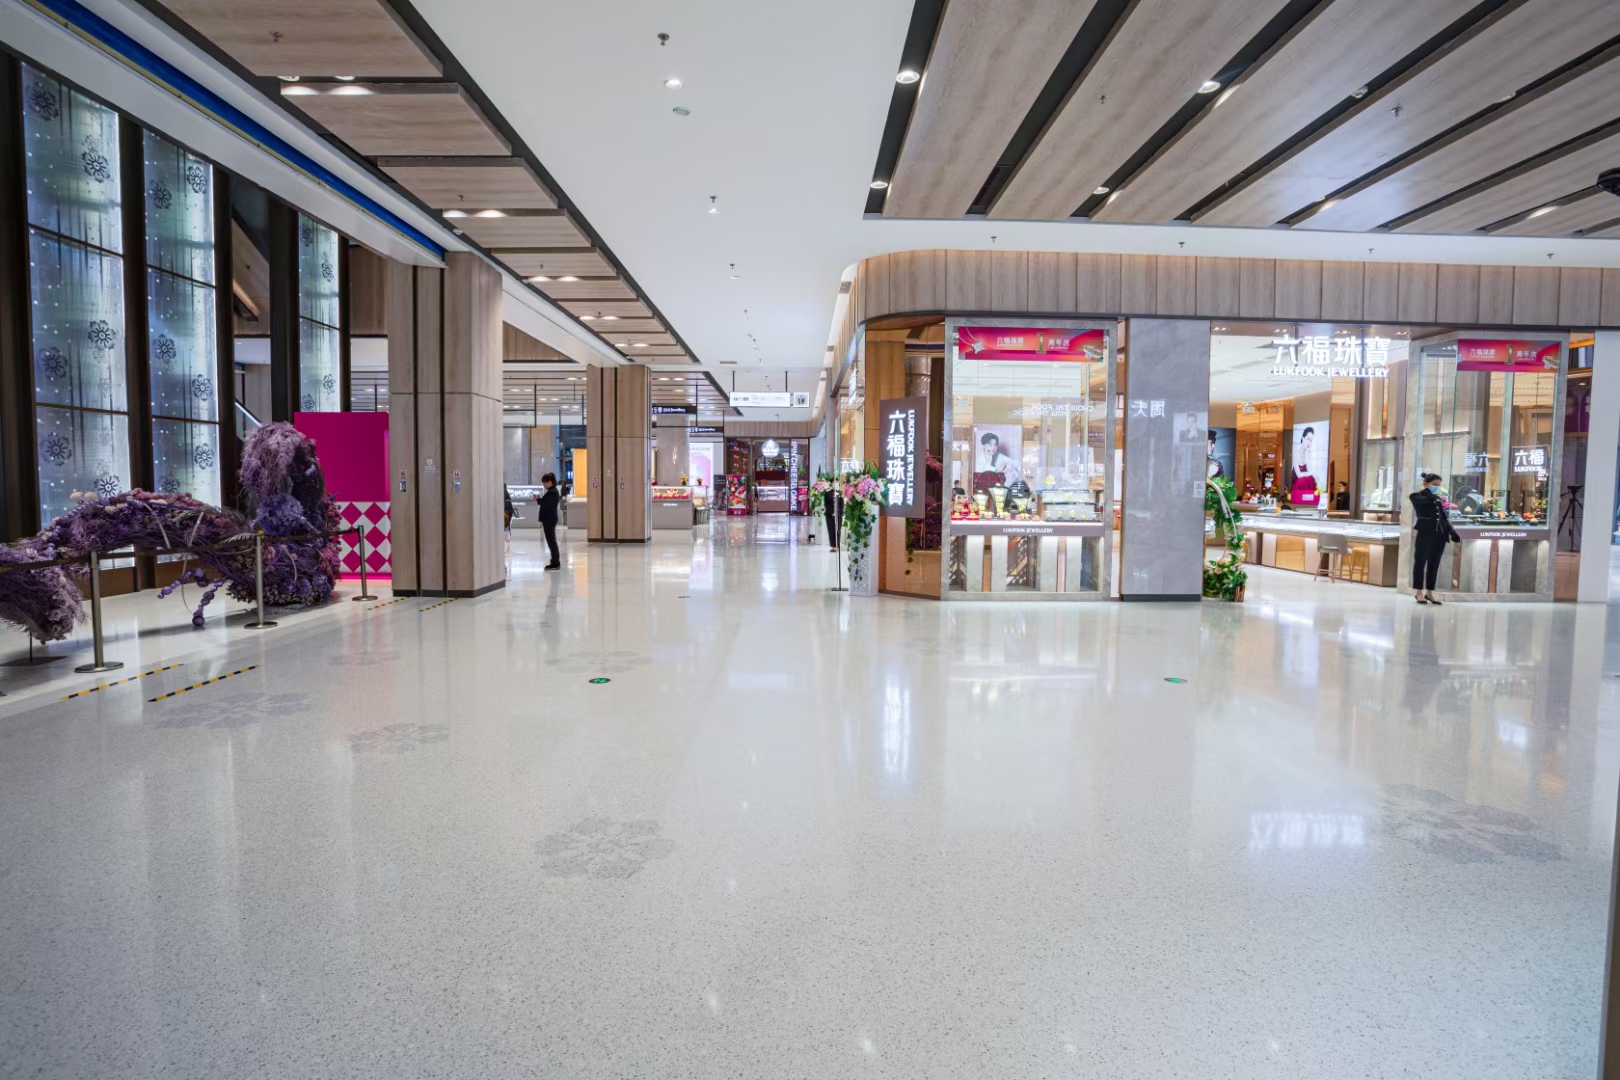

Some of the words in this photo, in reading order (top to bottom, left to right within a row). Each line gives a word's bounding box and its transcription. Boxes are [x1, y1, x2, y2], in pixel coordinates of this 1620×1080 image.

[1273, 334, 1391, 365] 六福珠寶
[1273, 366, 1325, 377] LUKFOOK
[1327, 367, 1390, 378] JEWELLERY
[907, 409, 915, 453] LUKFOOK
[886, 410, 906, 506] 六福珠寶
[1514, 449, 1545, 466] 六福
[906, 453, 915, 506] JEWELLERY
